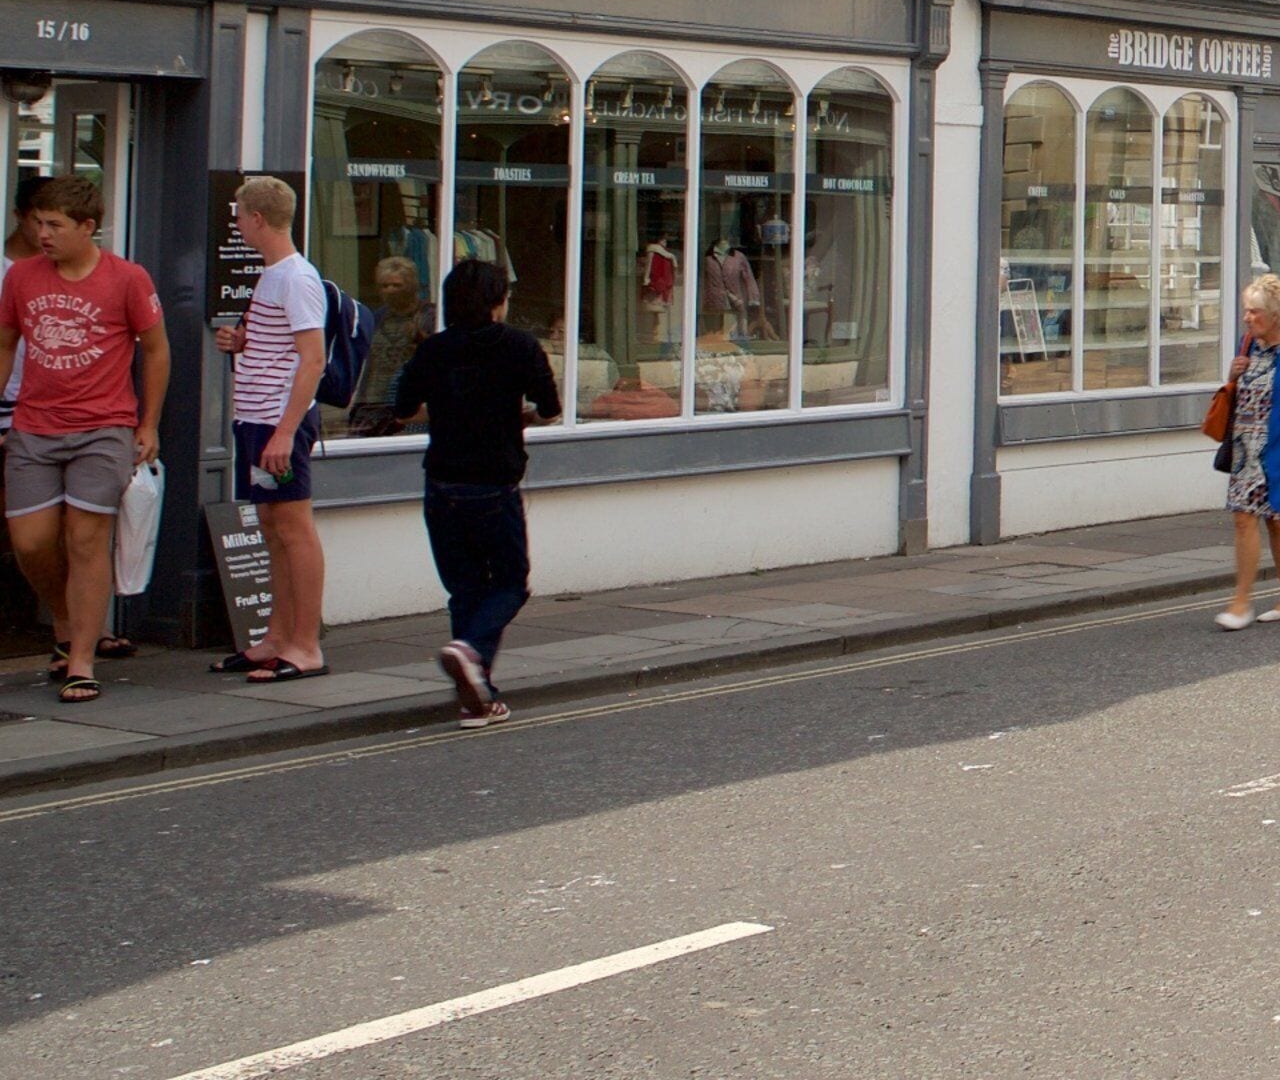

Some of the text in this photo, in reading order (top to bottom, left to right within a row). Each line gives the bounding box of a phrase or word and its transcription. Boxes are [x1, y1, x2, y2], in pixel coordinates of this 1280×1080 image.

[1107, 29, 1273, 79] the BRIDGE COFFEE shop
[347, 163, 406, 178] SANDWICHES
[493, 167, 532, 181] TOASTIES
[613, 172, 656, 185] CREAM TEA
[724, 175, 769, 188] MILKSHAKES
[838, 179, 874, 191] CHOCOLATE
[221, 285, 253, 299] Pulle
[26, 294, 102, 322] PHYSICAL
